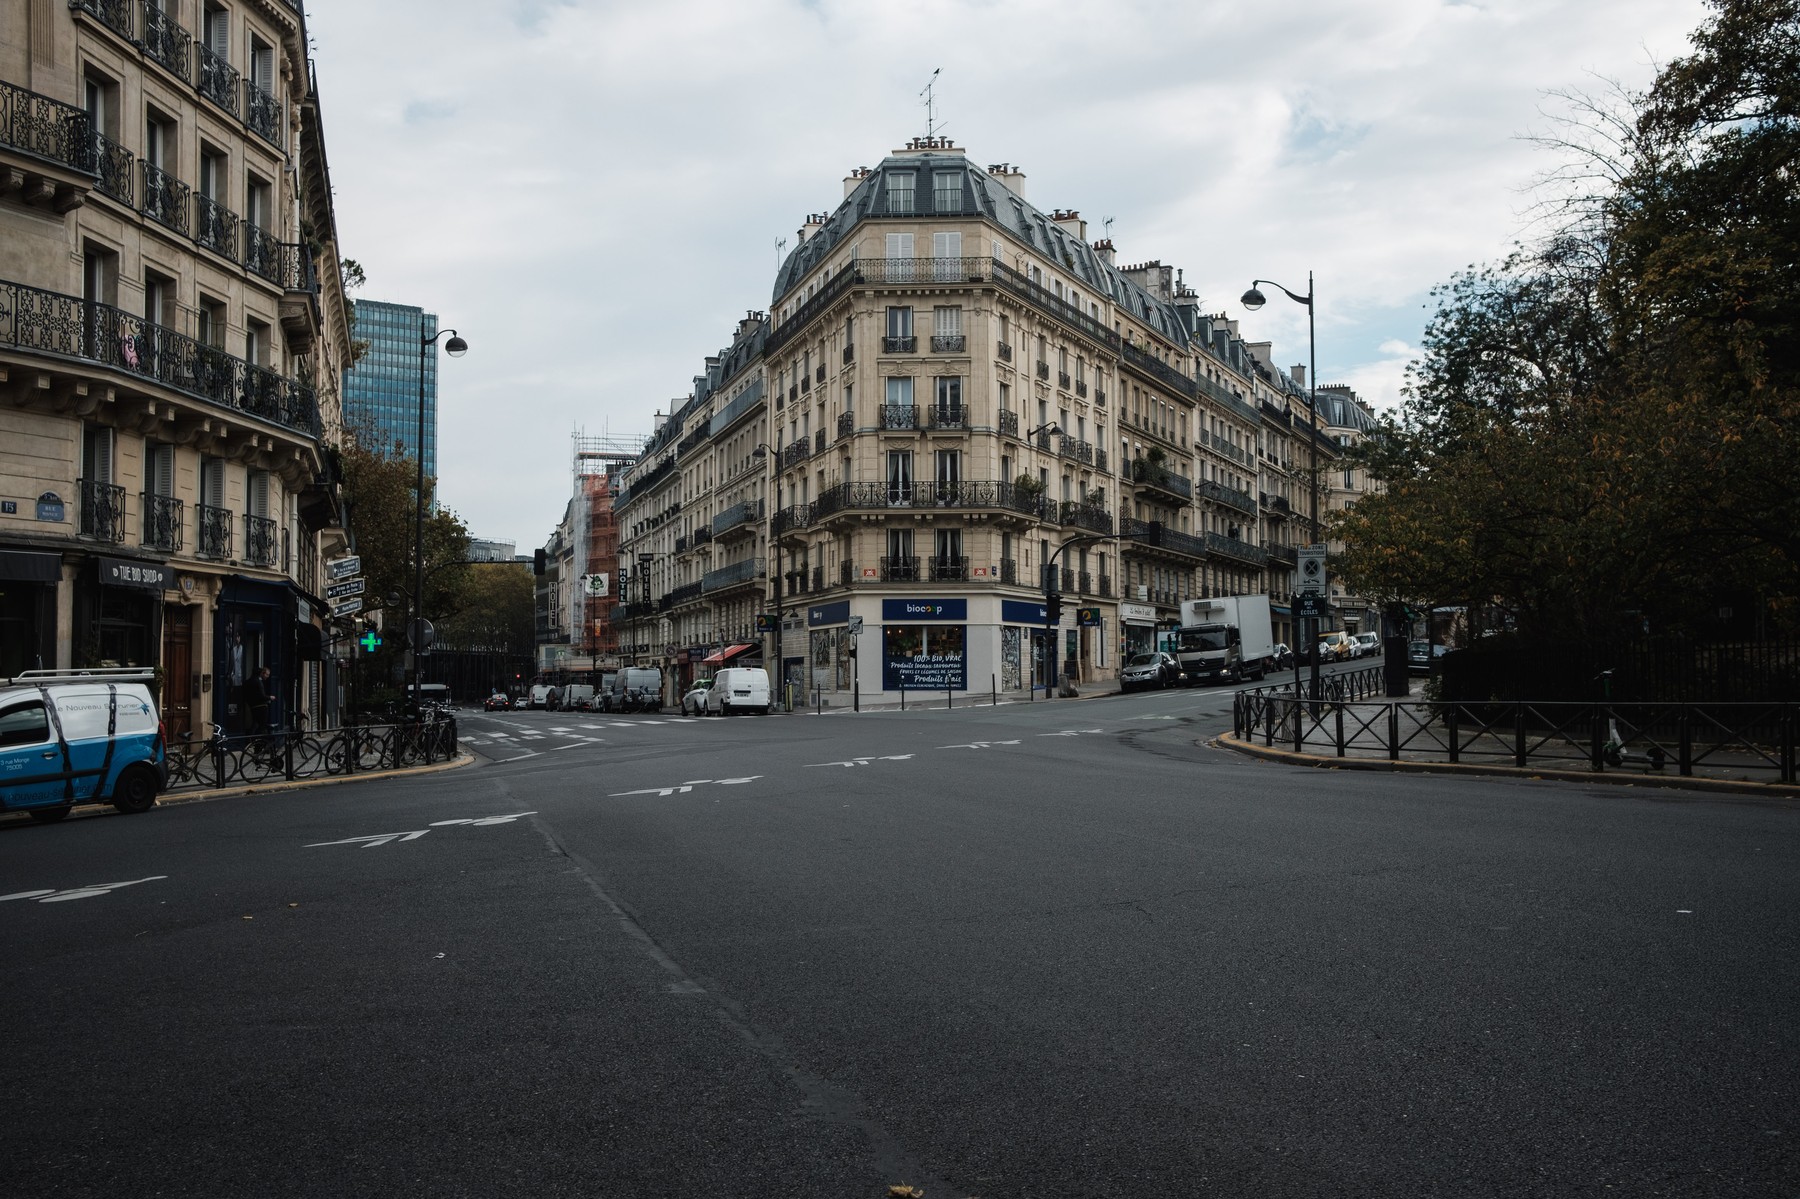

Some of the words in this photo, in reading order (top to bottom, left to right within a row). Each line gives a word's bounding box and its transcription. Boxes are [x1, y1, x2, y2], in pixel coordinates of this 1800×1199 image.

[5, 503, 14, 512] 15
[119, 565, 132, 581] THE
[619, 569, 627, 602] HOTEL
[906, 603, 943, 615] biocoop
[913, 654, 930, 663] 100%
[931, 654, 945, 663] BIO,
[945, 654, 962, 662] VRAC
[890, 661, 914, 669] Produits
[914, 674, 943, 683] Produits
[66, 704, 102, 712] Nouveau
[104, 702, 139, 710] Srurier
